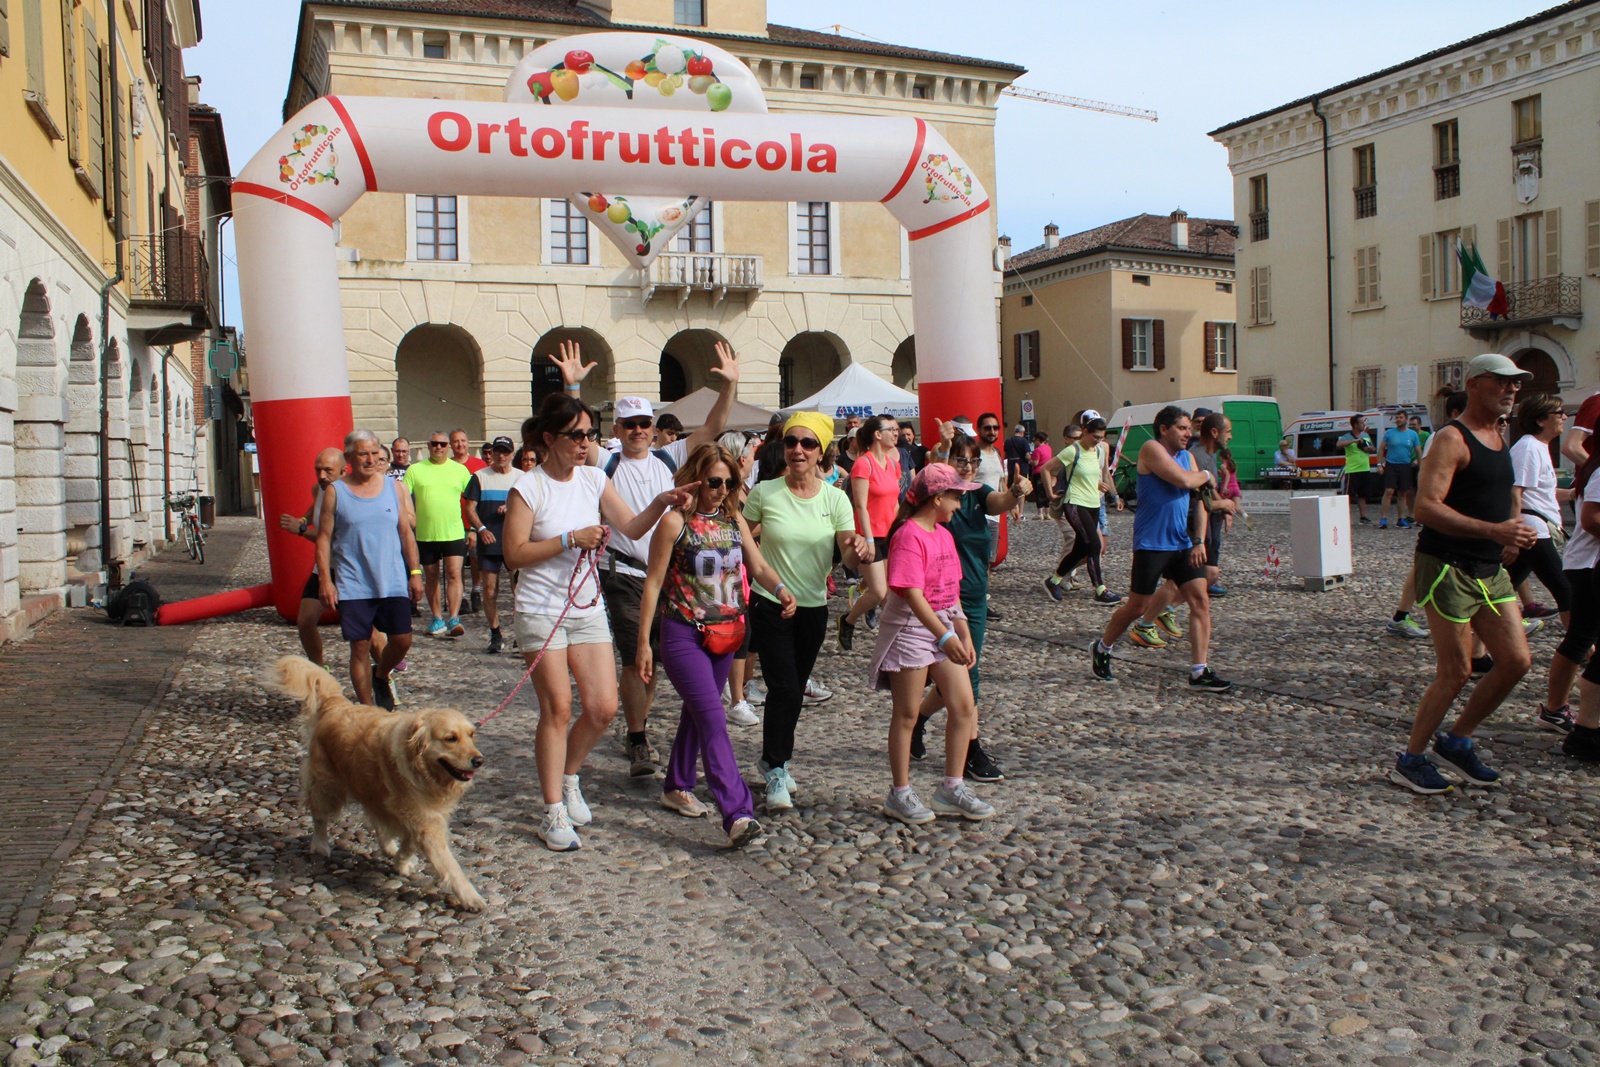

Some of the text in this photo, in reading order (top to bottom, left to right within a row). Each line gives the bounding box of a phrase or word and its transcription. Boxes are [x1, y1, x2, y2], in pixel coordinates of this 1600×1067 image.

[290, 127, 342, 191] Ortofrutticola
[427, 111, 837, 173] Ortofrutticola
[921, 161, 971, 207] Ortofrutticola
[835, 405, 873, 418] AVIS
[883, 406, 913, 417] Comunale
[687, 528, 743, 546] LOS ANGELE
